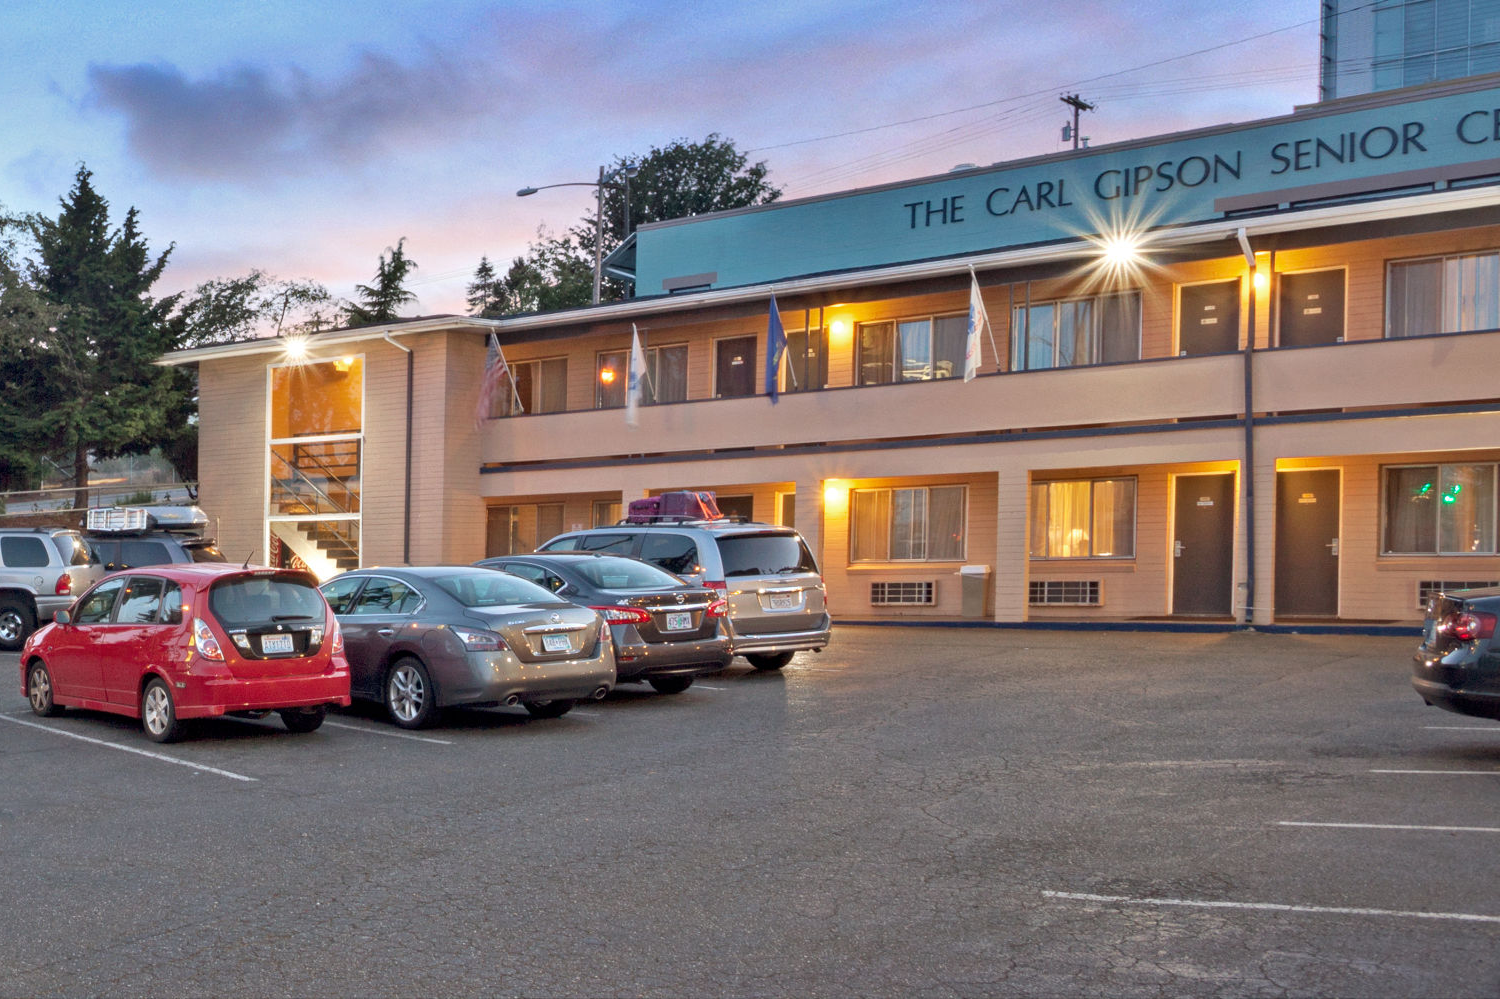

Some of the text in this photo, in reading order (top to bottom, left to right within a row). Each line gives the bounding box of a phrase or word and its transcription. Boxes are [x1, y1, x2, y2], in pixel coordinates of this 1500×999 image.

[904, 195, 964, 229] THE
[986, 179, 1072, 216] CARL
[1094, 151, 1242, 200] GIPSON
[1271, 121, 1428, 175] SENIOR
